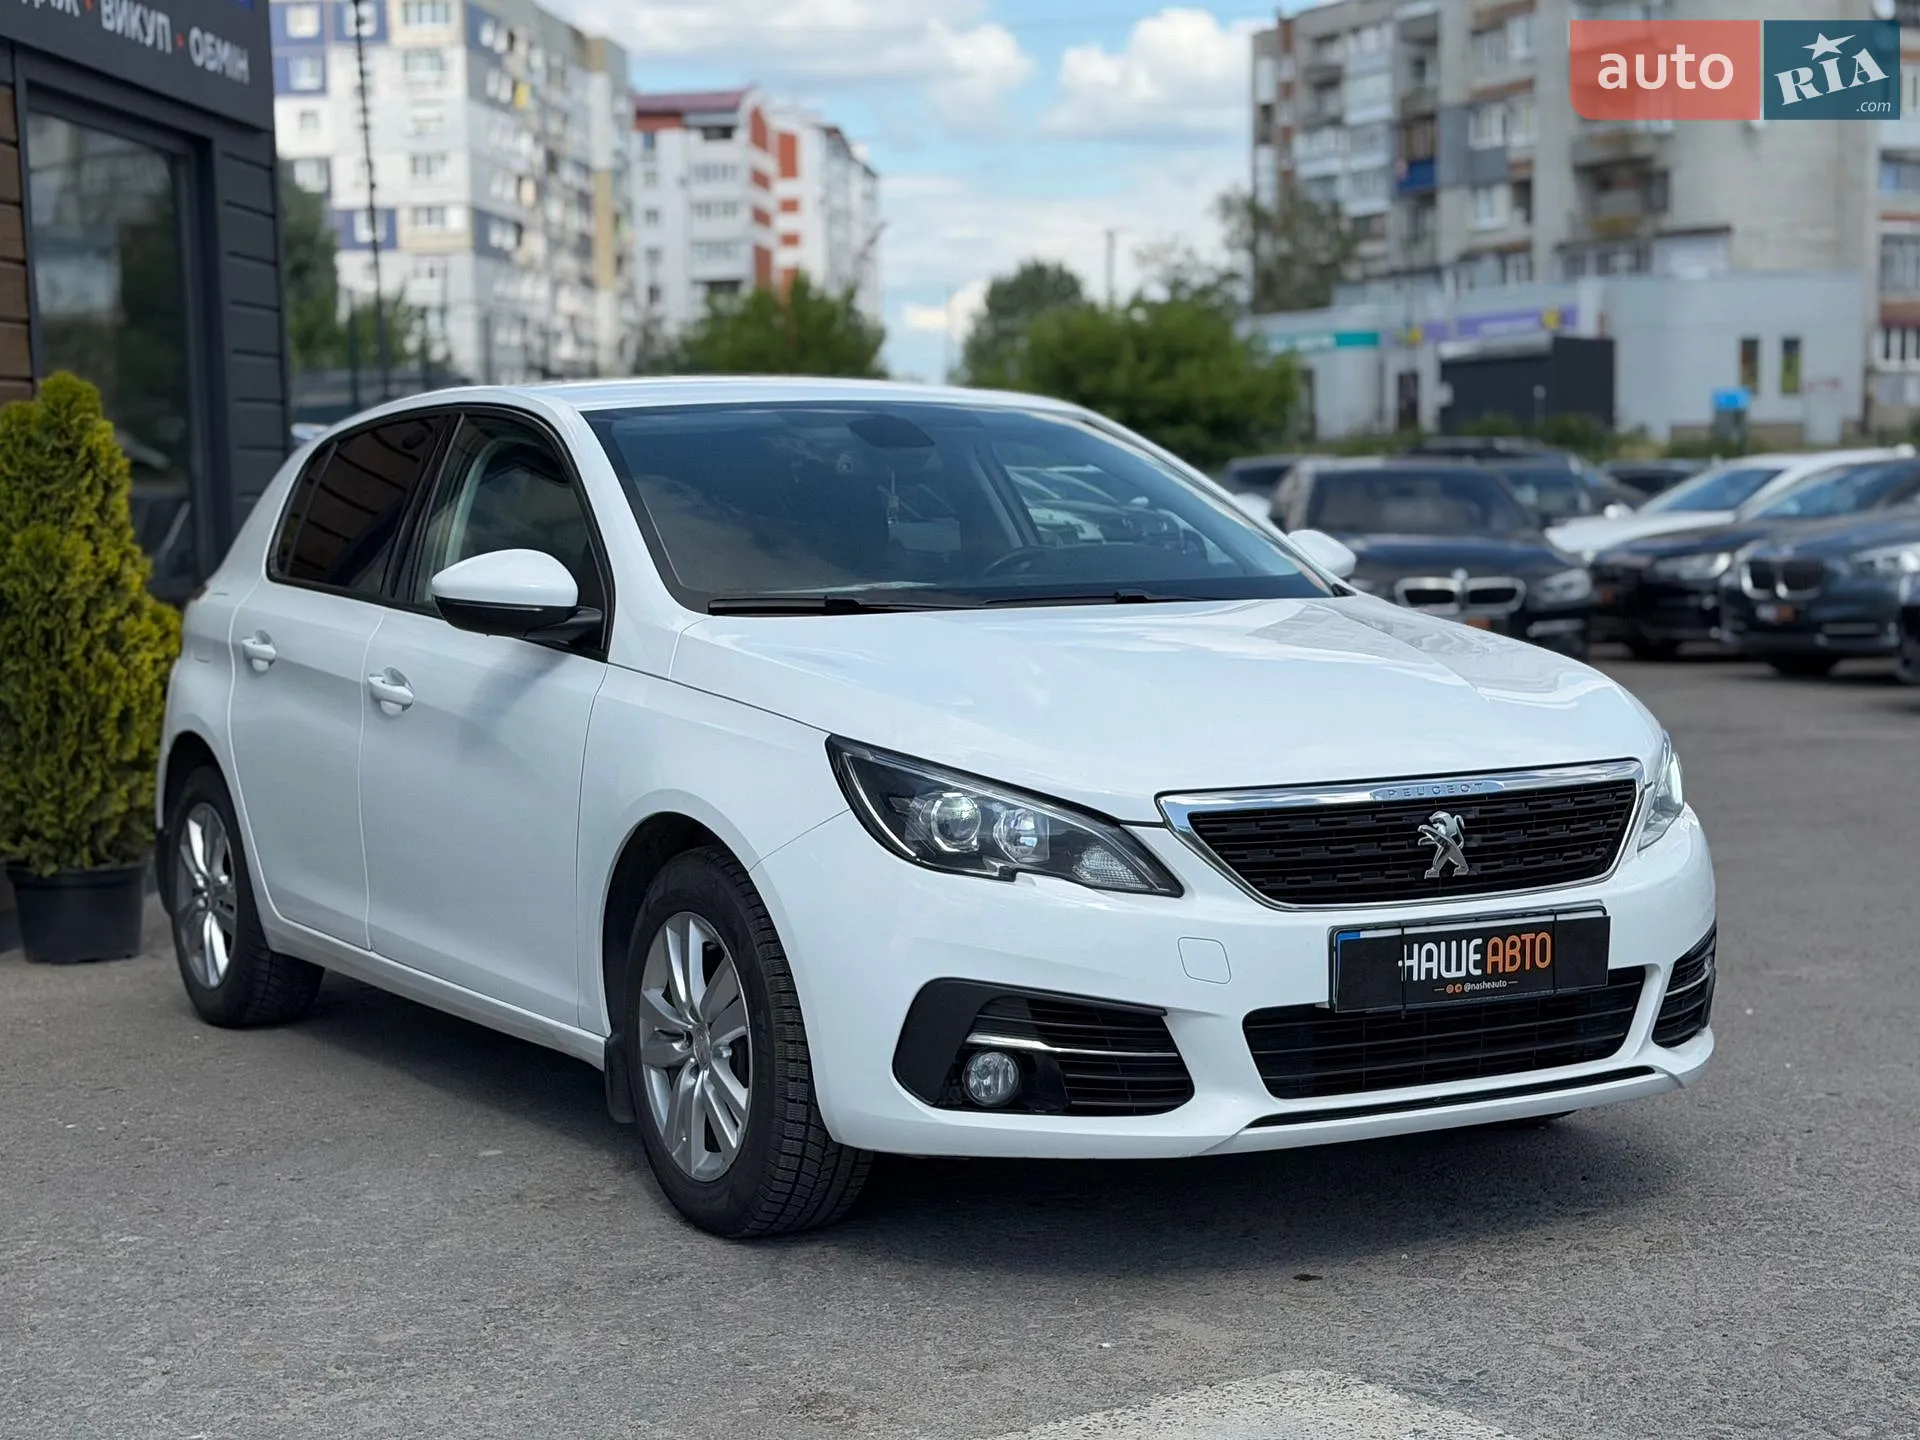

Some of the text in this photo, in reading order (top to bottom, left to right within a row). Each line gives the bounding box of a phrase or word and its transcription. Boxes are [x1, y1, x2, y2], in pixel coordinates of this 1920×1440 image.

[101, 0, 172, 54] ВИКУП
[1387, 782, 1483, 800] PEUGEOT
[1398, 931, 1552, 982] НАШЕ АВТО
[1463, 979, 1508, 993] @nasheauto
